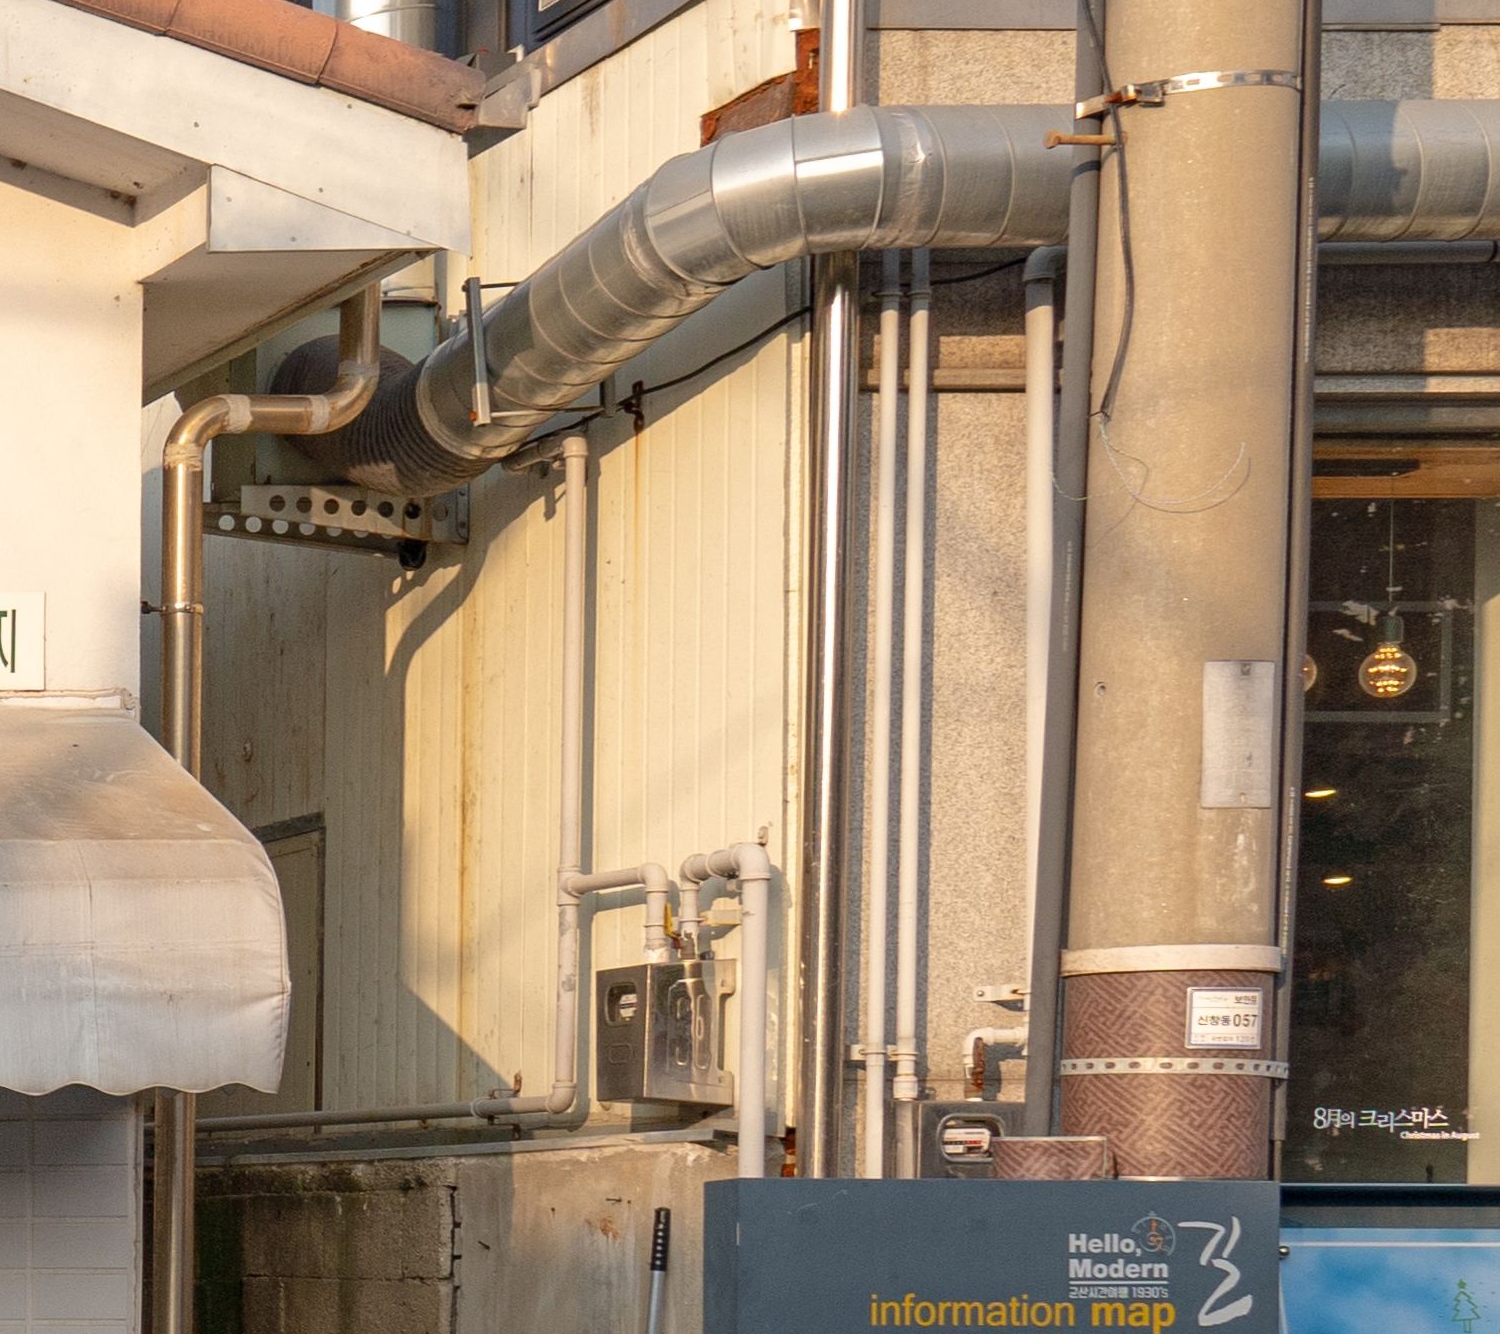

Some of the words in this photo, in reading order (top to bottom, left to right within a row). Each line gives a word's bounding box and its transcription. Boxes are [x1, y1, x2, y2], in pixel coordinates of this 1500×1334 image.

[1233, 1014, 1258, 1027] 057
[1313, 1107, 1355, 1130] 8月의
[1358, 1107, 1449, 1133] 크리스마스
[1400, 1131, 1440, 1142] Christmas
[1451, 1131, 1480, 1142] August
[1069, 1233, 1143, 1259] Hello,
[1069, 1258, 1169, 1279] Modern
[869, 1293, 1075, 1328] information
[1090, 1300, 1176, 1334] map
